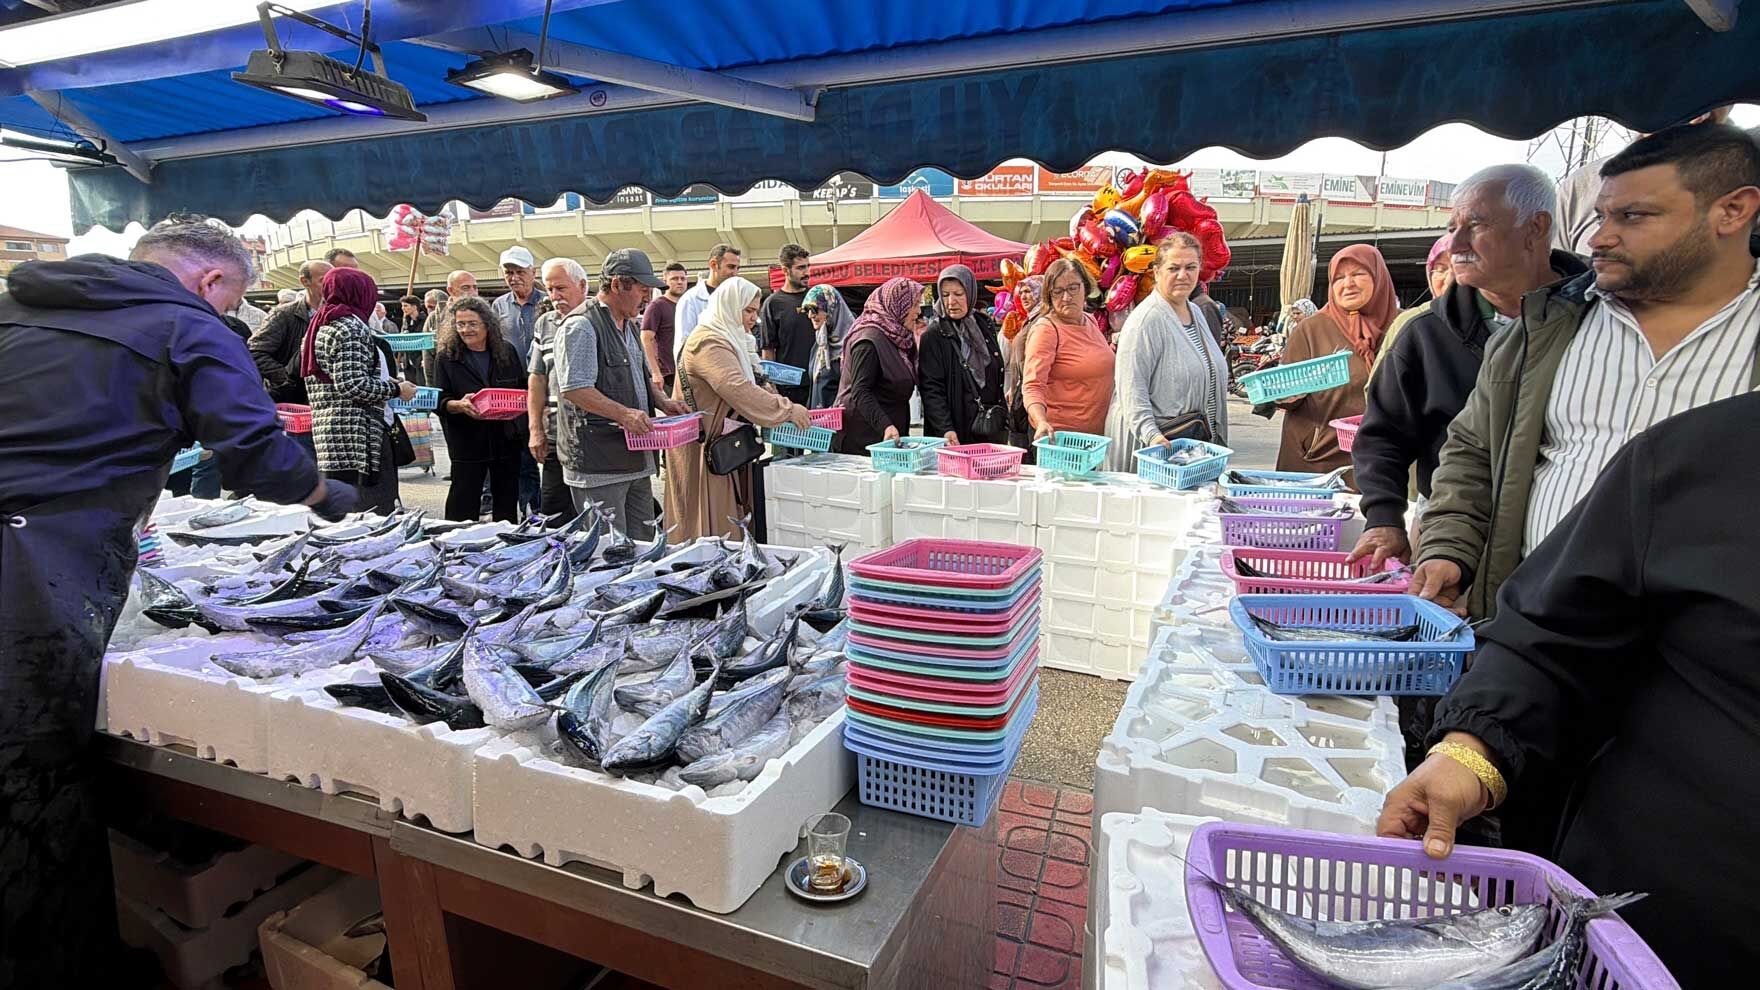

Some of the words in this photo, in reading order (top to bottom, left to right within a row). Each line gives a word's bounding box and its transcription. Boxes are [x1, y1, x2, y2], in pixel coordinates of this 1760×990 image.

[1324, 176, 1355, 192] EMİNE
[1380, 180, 1425, 196] EMİNEVİM
[854, 259, 942, 276] BELEDİYESİ
